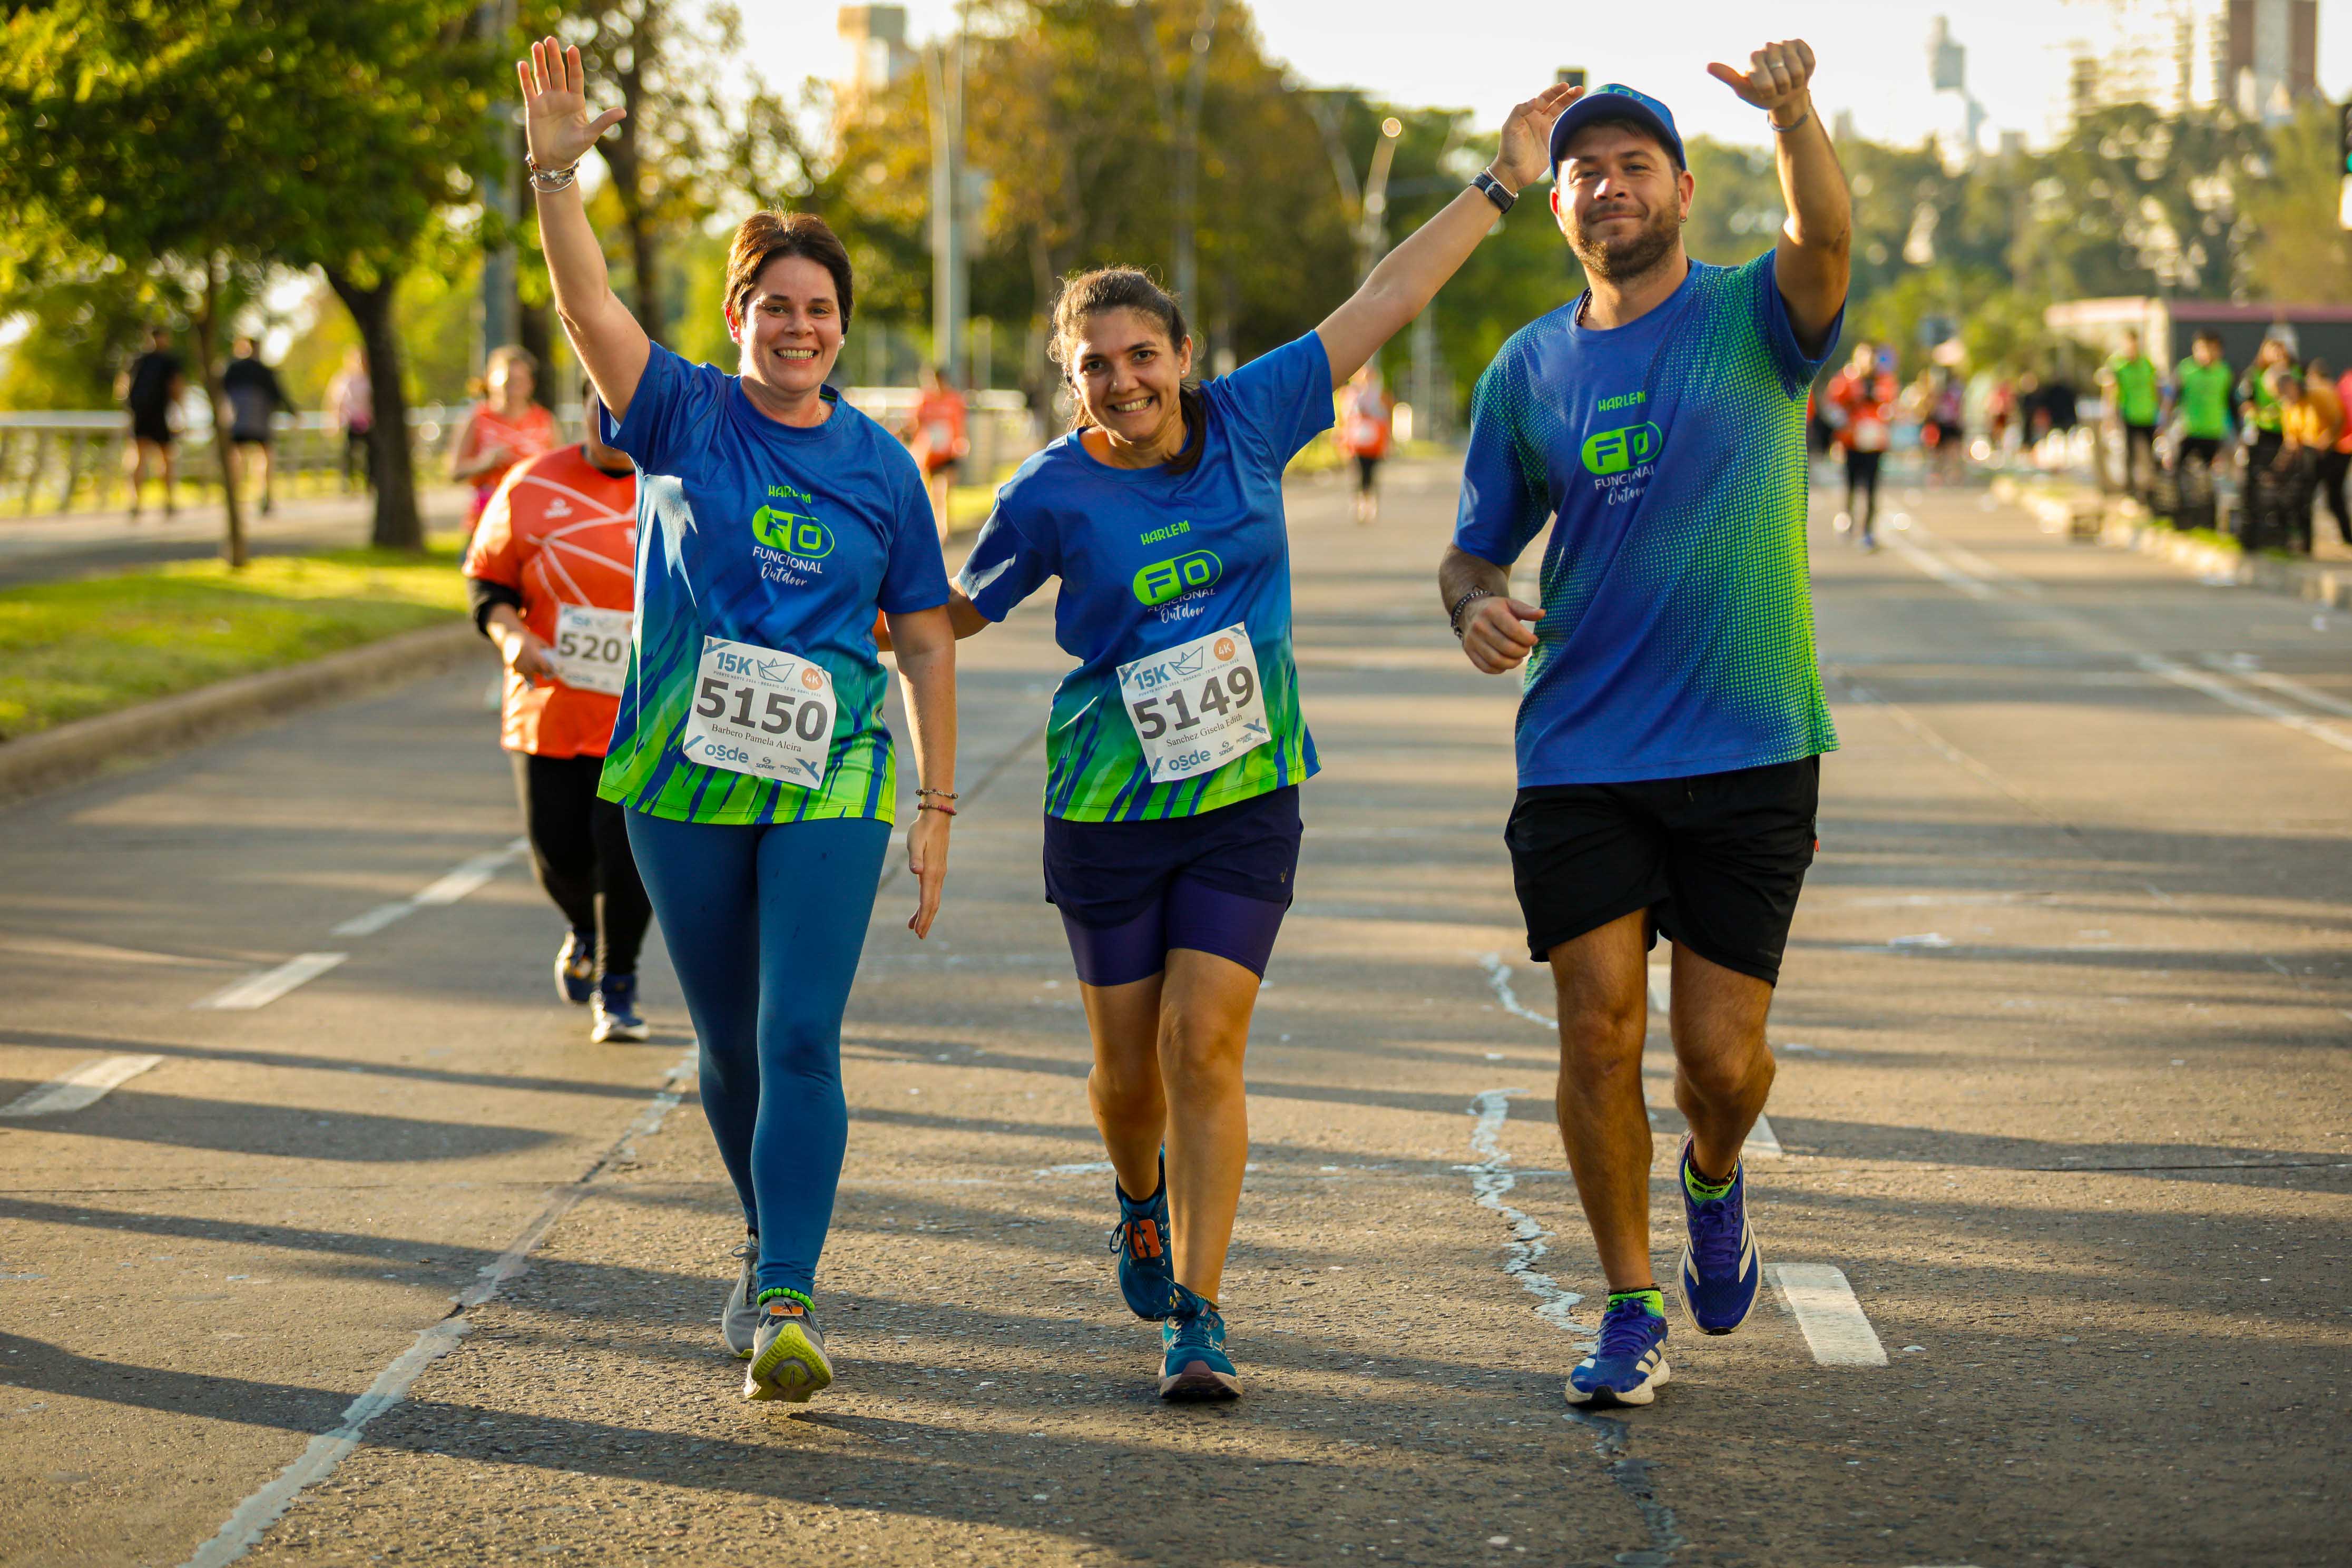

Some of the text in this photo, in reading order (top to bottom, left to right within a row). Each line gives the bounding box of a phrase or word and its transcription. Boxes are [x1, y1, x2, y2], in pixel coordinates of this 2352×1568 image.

[1598, 390, 1646, 412] HARLEM
[768, 484, 812, 504] HARLM
[1140, 520, 1191, 545] HARLEM
[752, 546, 822, 574] FUNCIONAL
[761, 561, 807, 586] Outdoor
[1161, 602, 1205, 623] Outdoor
[1218, 643, 1232, 655] 4K
[716, 652, 754, 676] 15K
[805, 674, 819, 684] 4K
[1134, 663, 1171, 690] 15K
[697, 677, 828, 742] 5150
[1133, 666, 1254, 739] 5149
[712, 723, 801, 752] Barbero Pamela Alcira
[1166, 713, 1243, 747] Sanchez Gisela Edith
[704, 744, 749, 763] osde
[1169, 749, 1211, 771] osde
